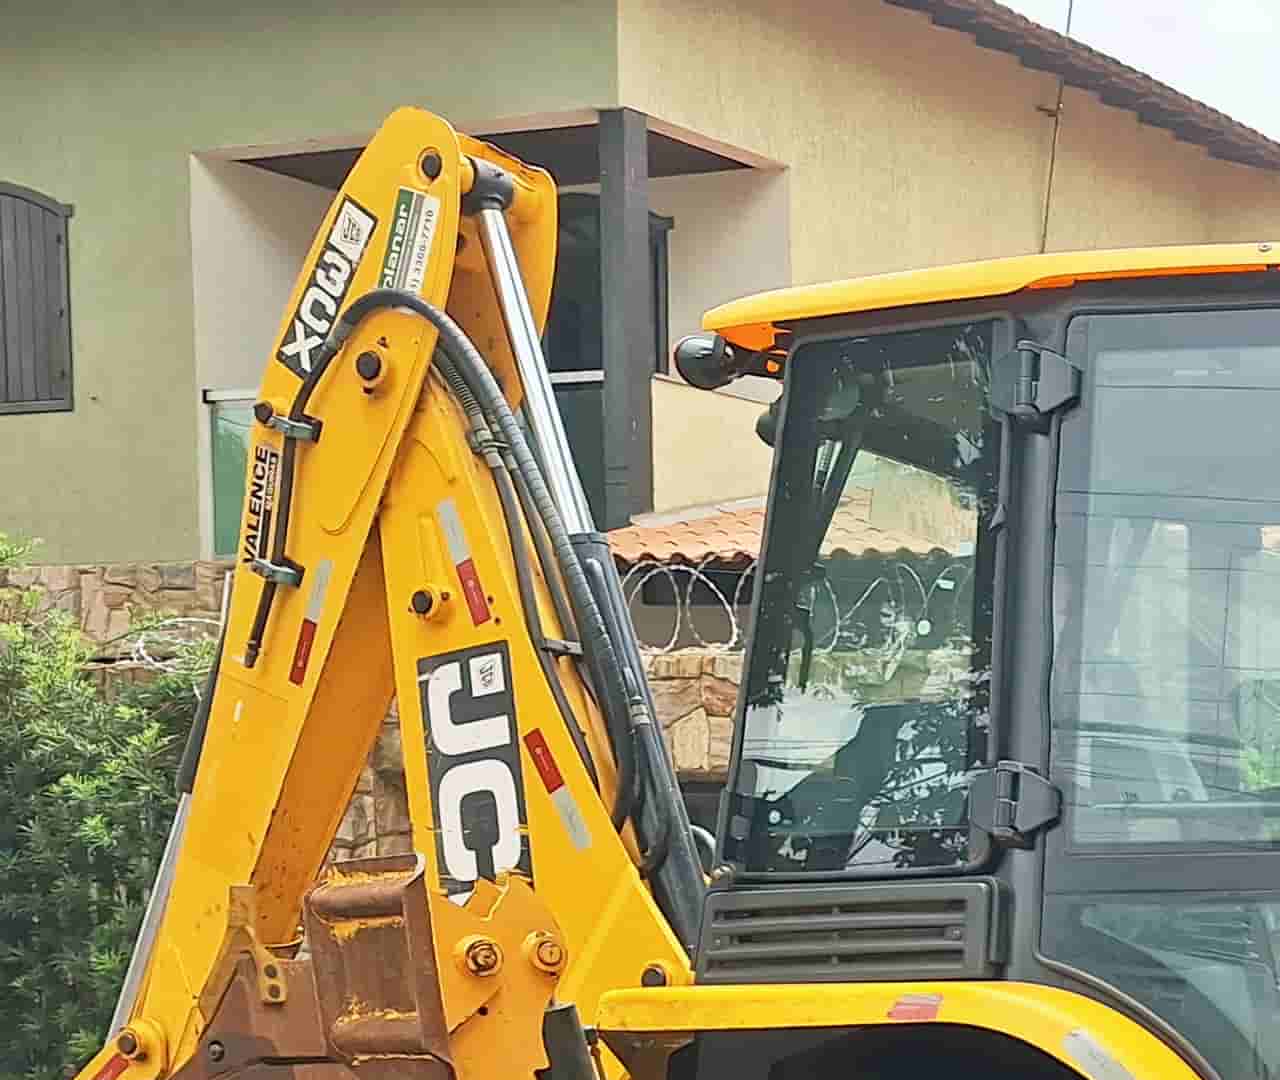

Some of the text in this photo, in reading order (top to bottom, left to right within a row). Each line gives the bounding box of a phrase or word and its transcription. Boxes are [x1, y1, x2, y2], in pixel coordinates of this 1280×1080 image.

[280, 249, 353, 373] 3CX
[242, 446, 268, 563] VALENCE
[428, 652, 522, 906] JC
